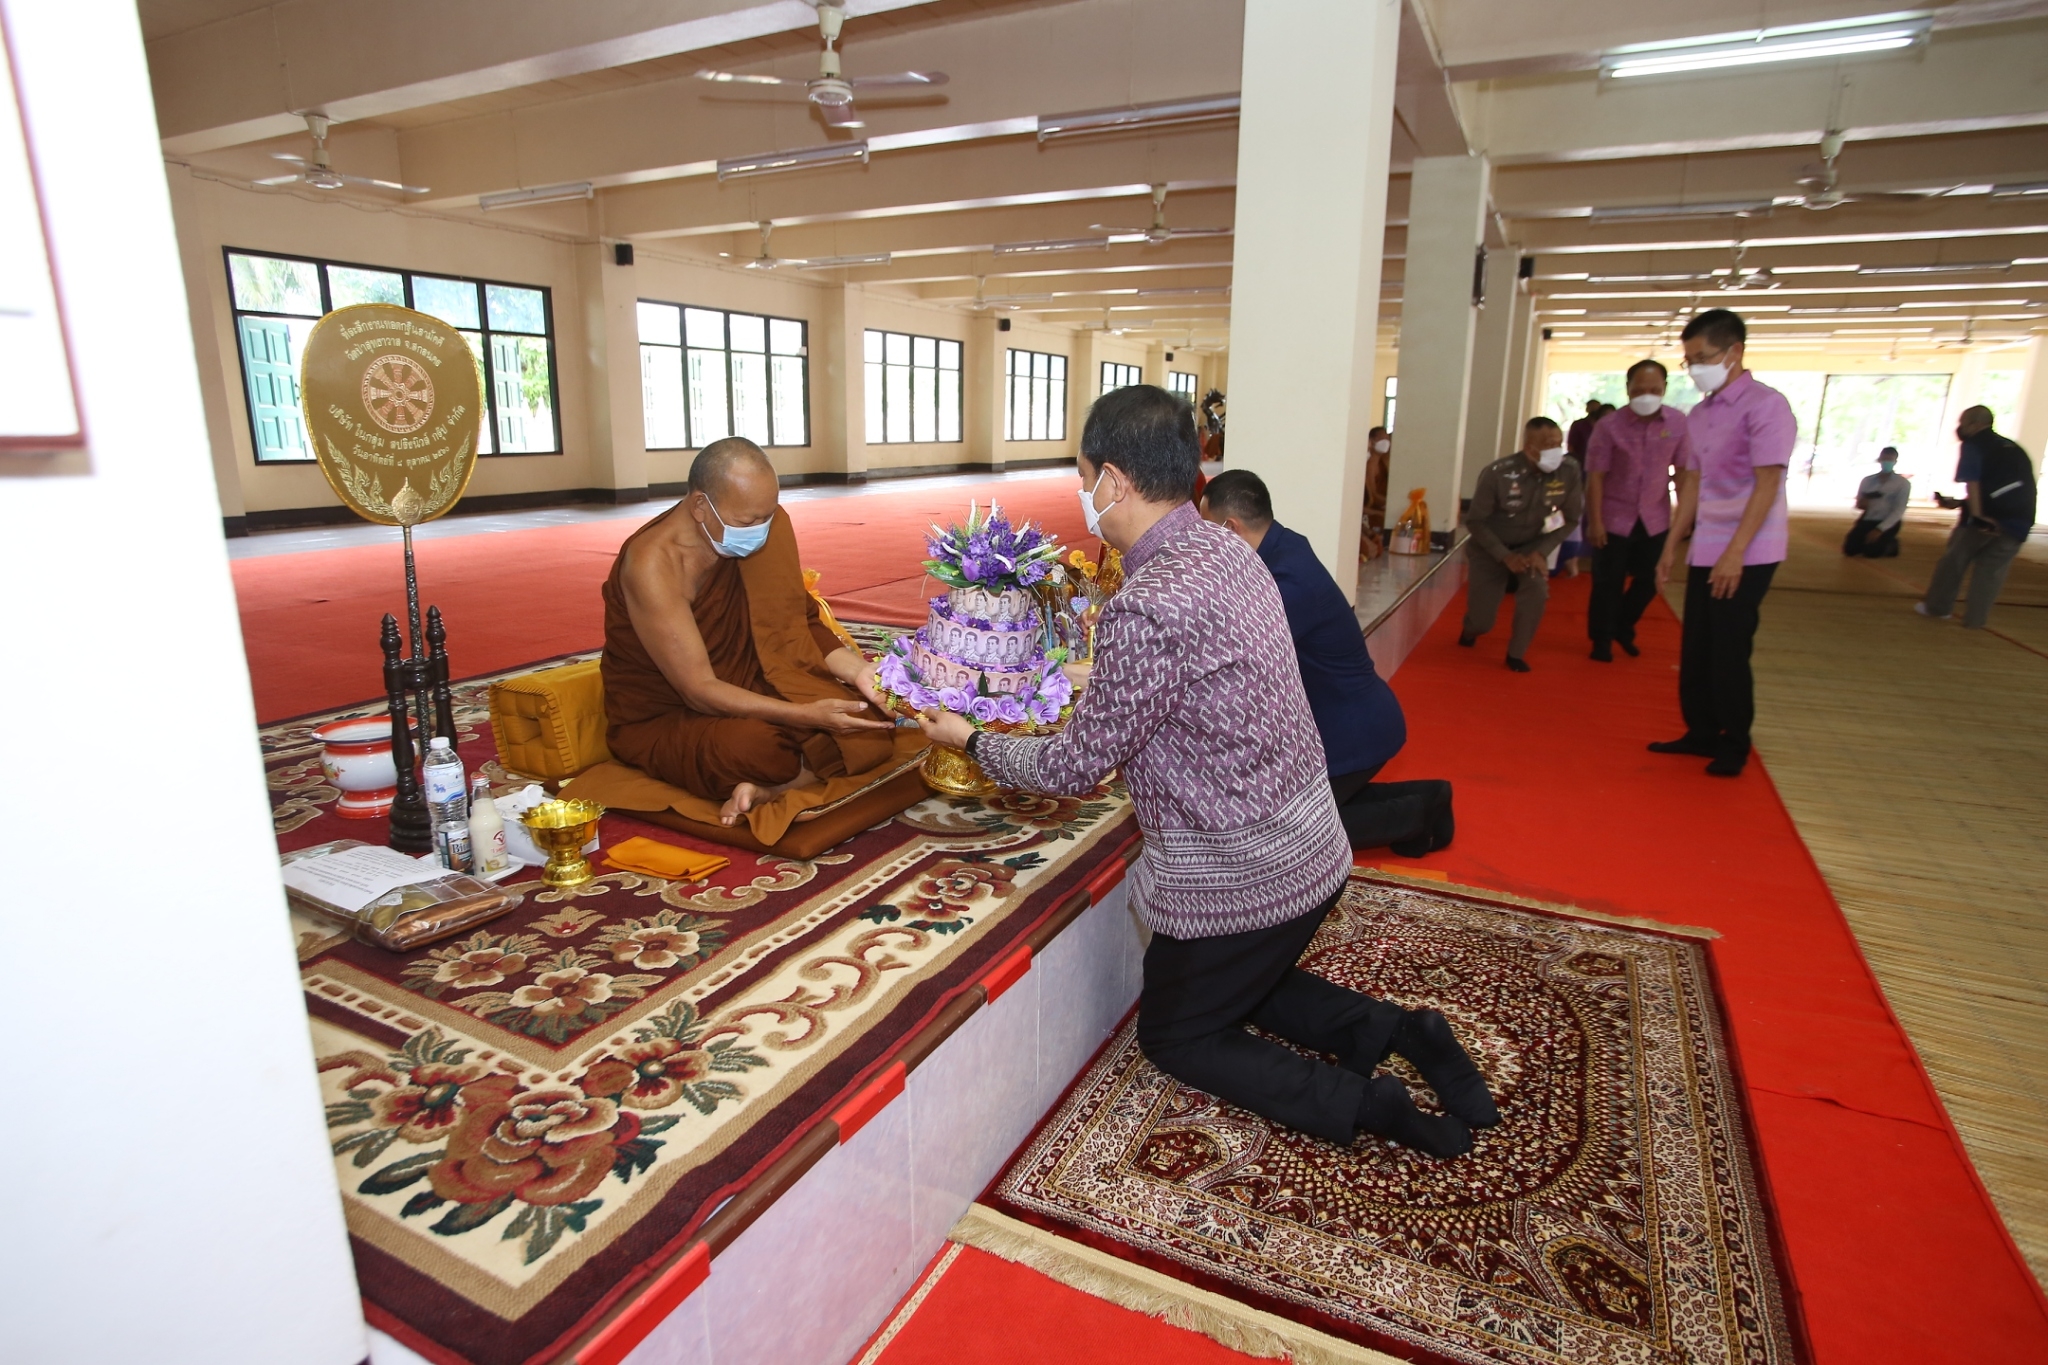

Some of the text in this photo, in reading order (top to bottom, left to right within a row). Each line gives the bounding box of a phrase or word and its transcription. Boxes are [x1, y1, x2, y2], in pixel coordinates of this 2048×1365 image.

[340, 320, 445, 347] ที่ระลึกงานทอดกฐินสามัคคี
[344, 337, 442, 367] วัดป่าสุทธาวาส จ.สกลนคร
[328, 404, 354, 431] บริษัท
[355, 423, 385, 449] ในกลุ่ม
[447, 405, 466, 426] จำกัด
[353, 444, 395, 467] วันอาทิตย์ที่
[406, 455, 431, 470] ตุลาคม
